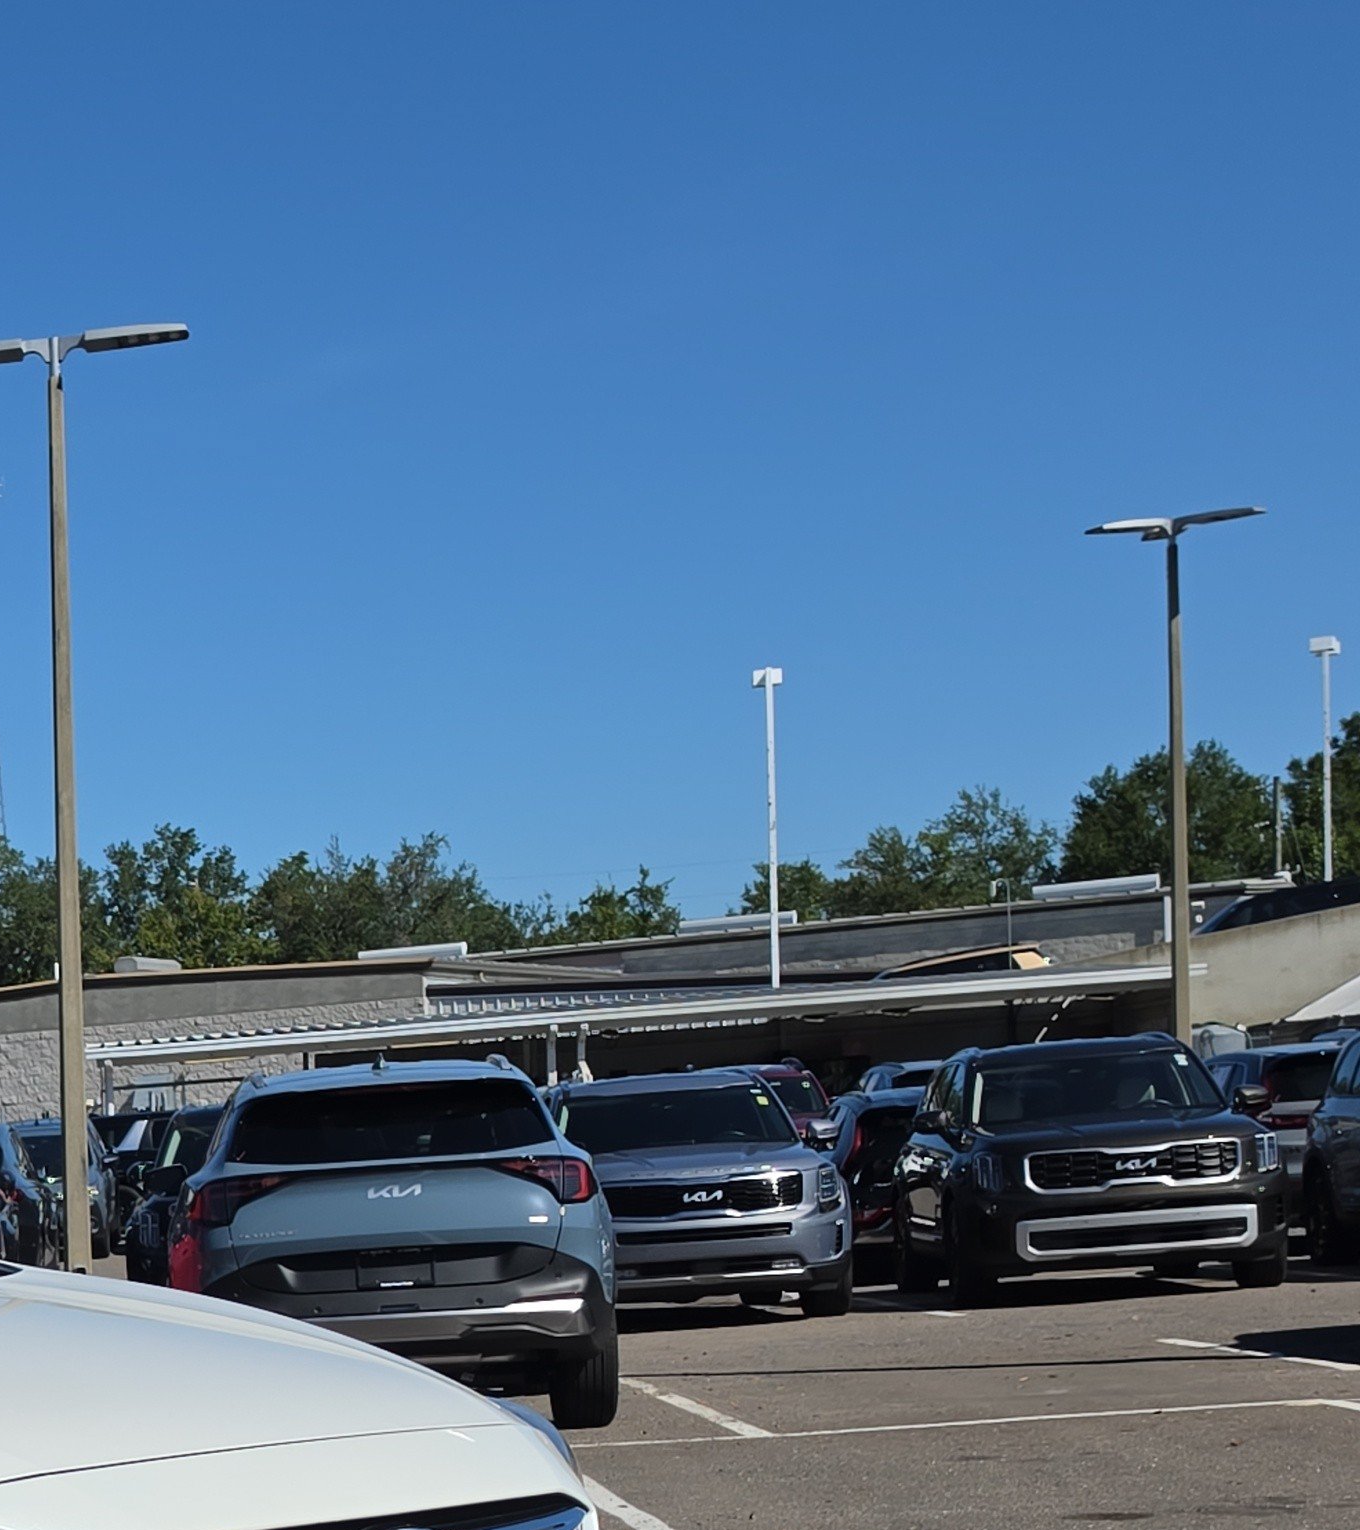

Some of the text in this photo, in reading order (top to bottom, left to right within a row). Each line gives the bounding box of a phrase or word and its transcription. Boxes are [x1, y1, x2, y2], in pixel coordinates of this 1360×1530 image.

[1115, 1157, 1158, 1171] KIA
[367, 1183, 422, 1200] KIA
[682, 1190, 723, 1204] KIA
